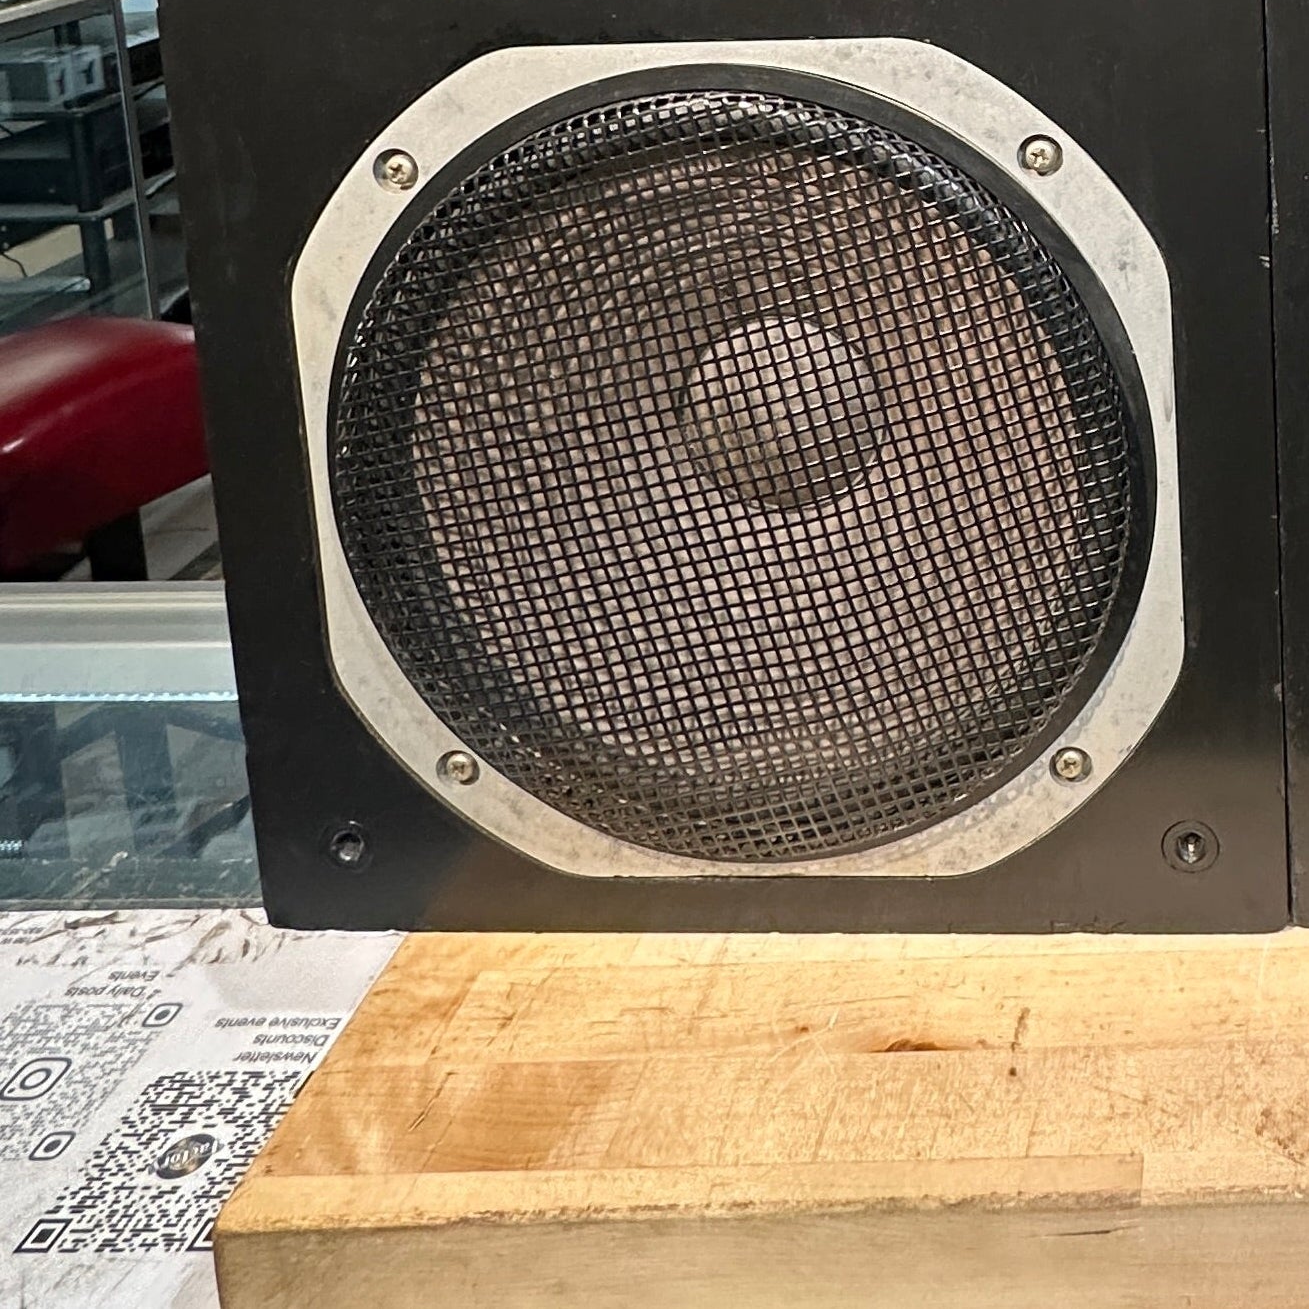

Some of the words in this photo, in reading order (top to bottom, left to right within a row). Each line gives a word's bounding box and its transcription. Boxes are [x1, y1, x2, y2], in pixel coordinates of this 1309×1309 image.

[107, 970, 161, 982] Events
[64, 985, 108, 998] posts
[108, 984, 146, 998] Daily
[215, 1016, 267, 1029] events
[269, 1017, 342, 1030] Exclusive
[252, 1033, 330, 1047] Discounts
[232, 1050, 318, 1064] Newsletter
